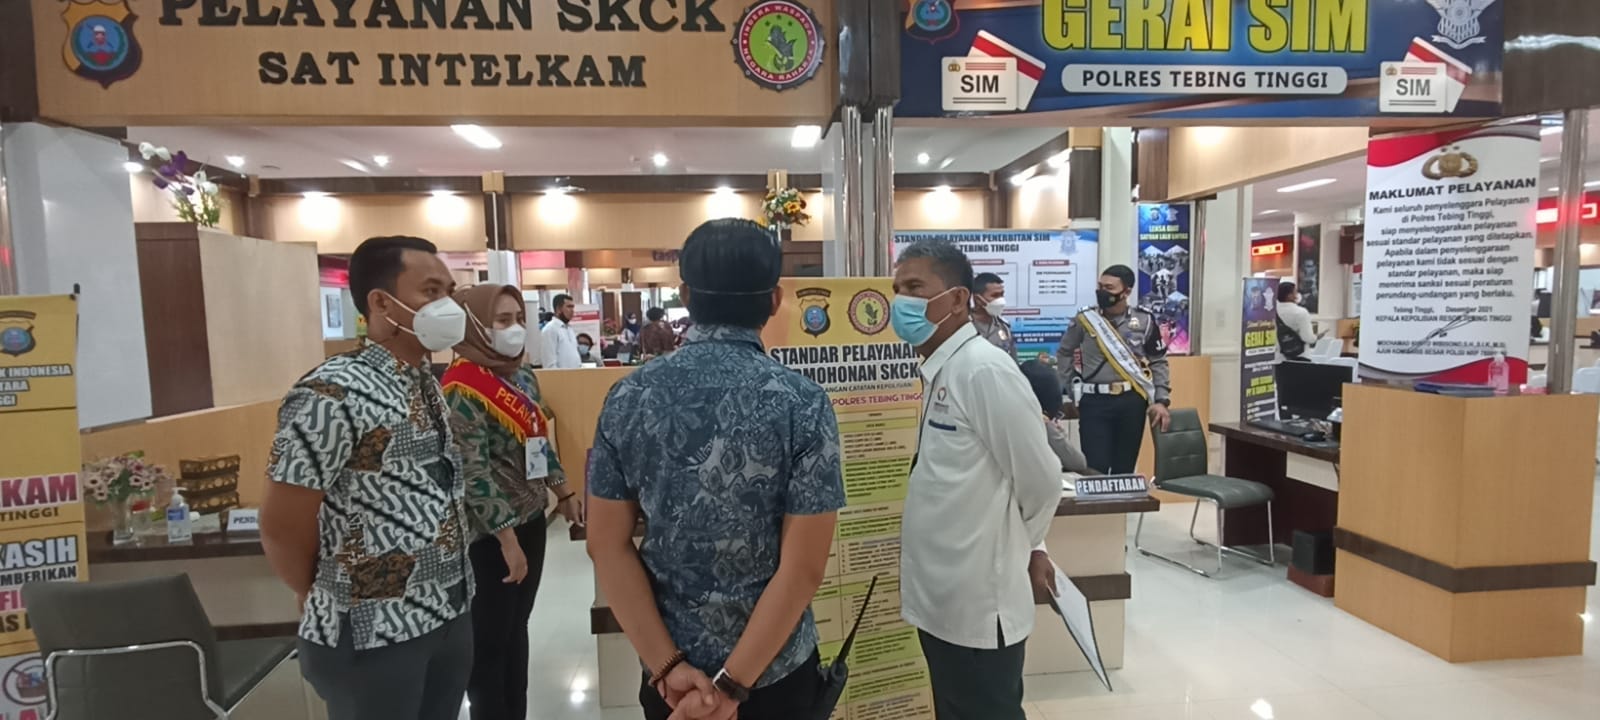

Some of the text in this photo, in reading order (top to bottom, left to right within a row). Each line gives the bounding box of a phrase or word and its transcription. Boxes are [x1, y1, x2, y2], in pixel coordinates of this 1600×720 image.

[159, 0, 726, 32] PELAYANAN SKCK
[1041, 0, 1368, 53] GERAI SIM
[258, 51, 647, 88] SAT INTELKAM
[960, 75, 999, 93] SIM
[1082, 70, 1328, 88] POLRES TEBING TINGGI
[1396, 78, 1431, 96] SIM
[1369, 177, 1536, 200] MAKLUMAT PELAYANAN
[1373, 196, 1529, 215] Kami seluruh penyelenggara Pelayanan
[1402, 215, 1408, 223] di
[1410, 213, 1435, 222] Polres
[1438, 211, 1465, 223] Tebing
[1381, 220, 1517, 236] siap menyelenggarakan pelayanan
[982, 233, 1032, 242] PENERBITAN
[1034, 233, 1050, 241] SIM
[1367, 238, 1390, 246] sesuai
[1391, 235, 1420, 245] standar
[1422, 234, 1462, 246] pelayanan
[1464, 233, 1484, 244] yang
[959, 244, 1019, 252] TEBING TINGGI
[1385, 244, 1510, 258] Apabila dalam penyelenggaraan
[1376, 255, 1518, 269] pelayanan kami tidak sesuai dengan
[1388, 268, 1416, 278] standar
[1462, 267, 1484, 275] maka
[1486, 267, 1503, 277] siap
[1379, 278, 1513, 288] menerima sanksi sesuai peraturan
[1376, 290, 1457, 301] perundang-undangan
[1459, 290, 1479, 300] yang
[770, 346, 838, 366] STANDAR
[9, 364, 72, 377] INDONESIA
[880, 362, 921, 381] SKCK
[832, 397, 866, 406] POLRES
[868, 394, 899, 404] TEBING
[1, 474, 78, 507] KAM
[1077, 478, 1146, 494] PENDAFTARAN
